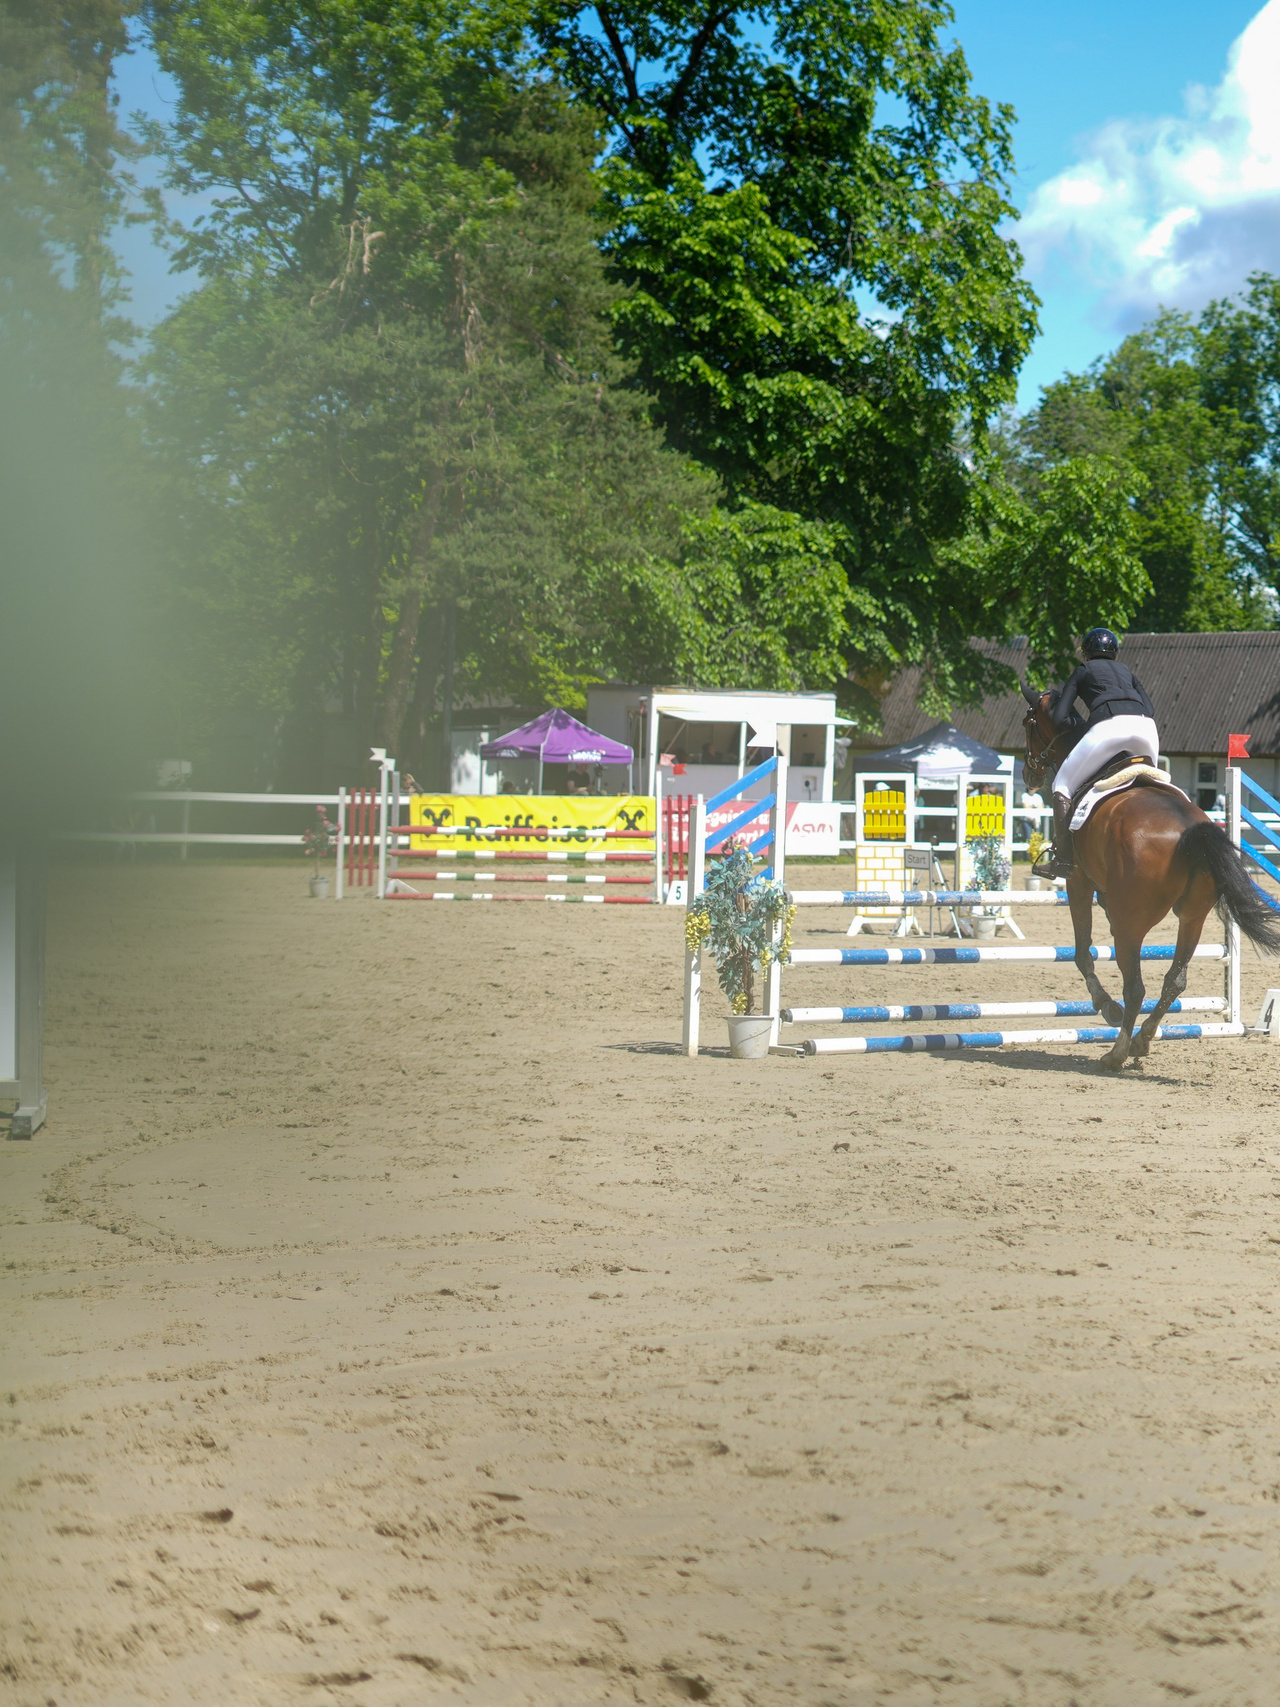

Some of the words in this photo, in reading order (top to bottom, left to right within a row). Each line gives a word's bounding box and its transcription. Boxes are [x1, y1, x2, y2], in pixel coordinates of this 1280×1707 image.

[908, 855, 926, 864] Start
[675, 886, 682, 900] 5
[1263, 998, 1275, 1029] 4
